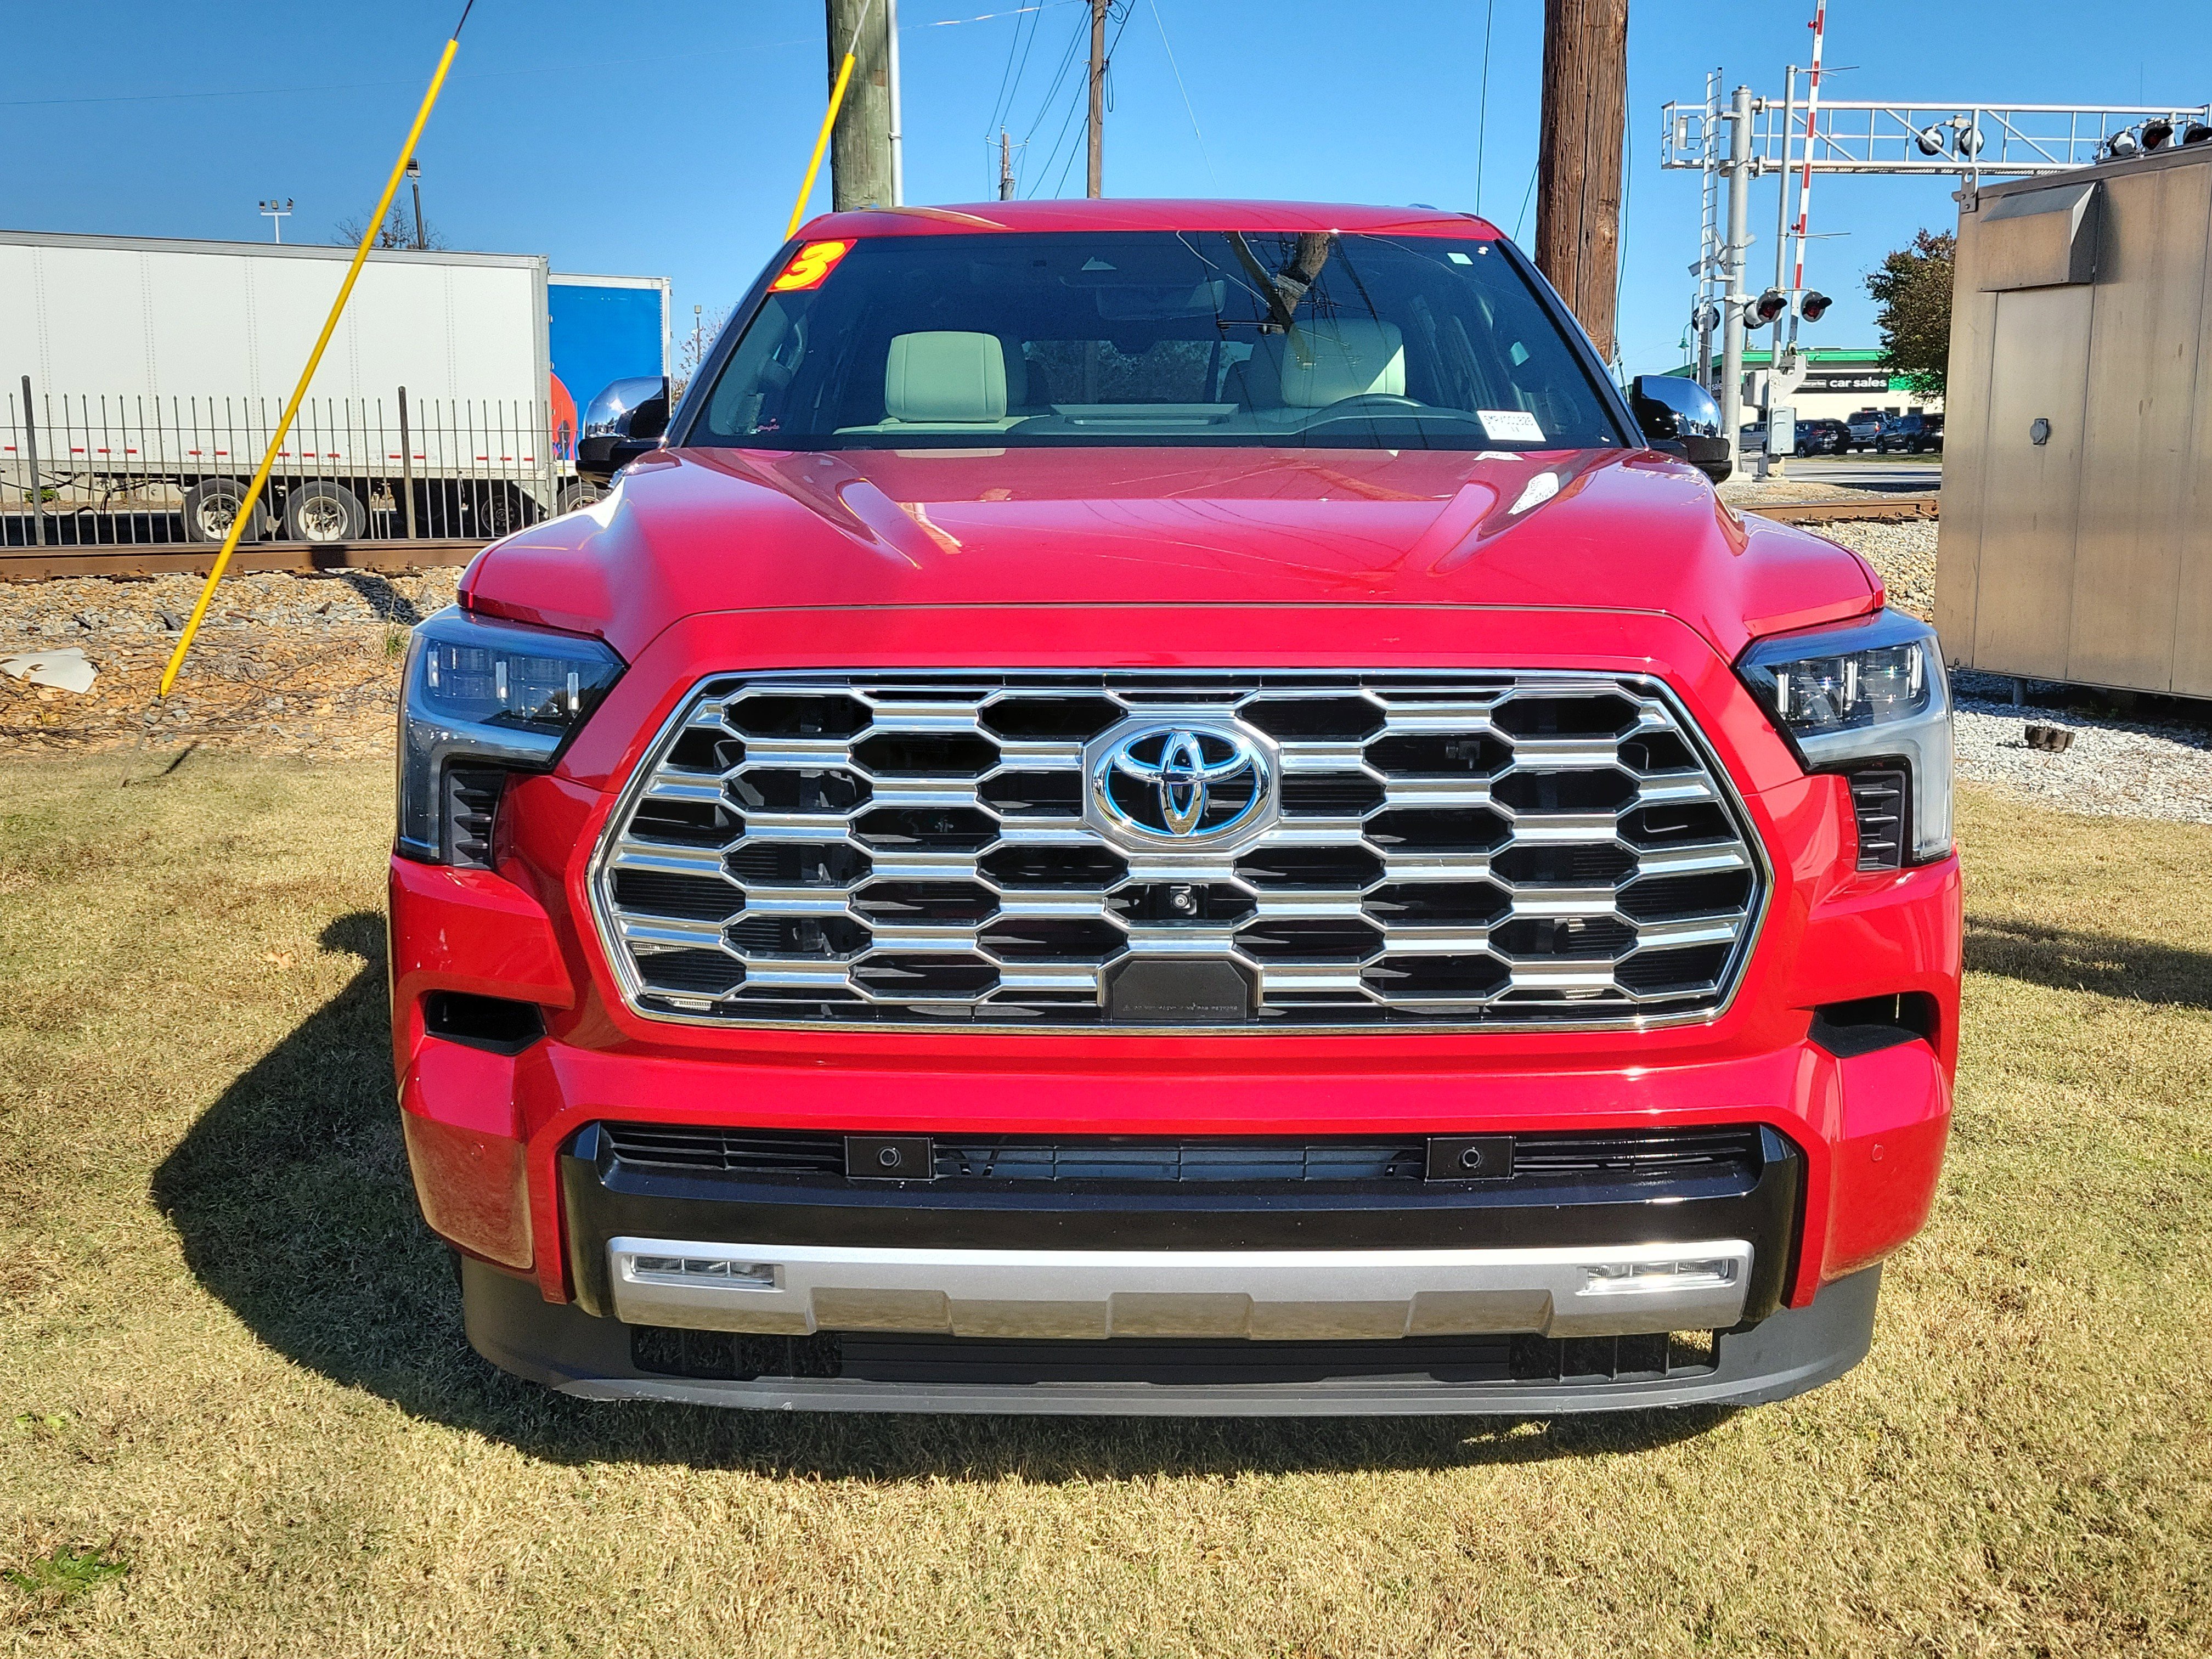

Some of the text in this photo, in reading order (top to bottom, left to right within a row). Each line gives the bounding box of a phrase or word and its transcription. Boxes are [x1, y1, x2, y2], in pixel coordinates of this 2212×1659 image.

[774, 241, 846, 290] 3
[1712, 380, 1723, 391] sale
[1829, 379, 1852, 388] car
[1853, 376, 1887, 388] sales
